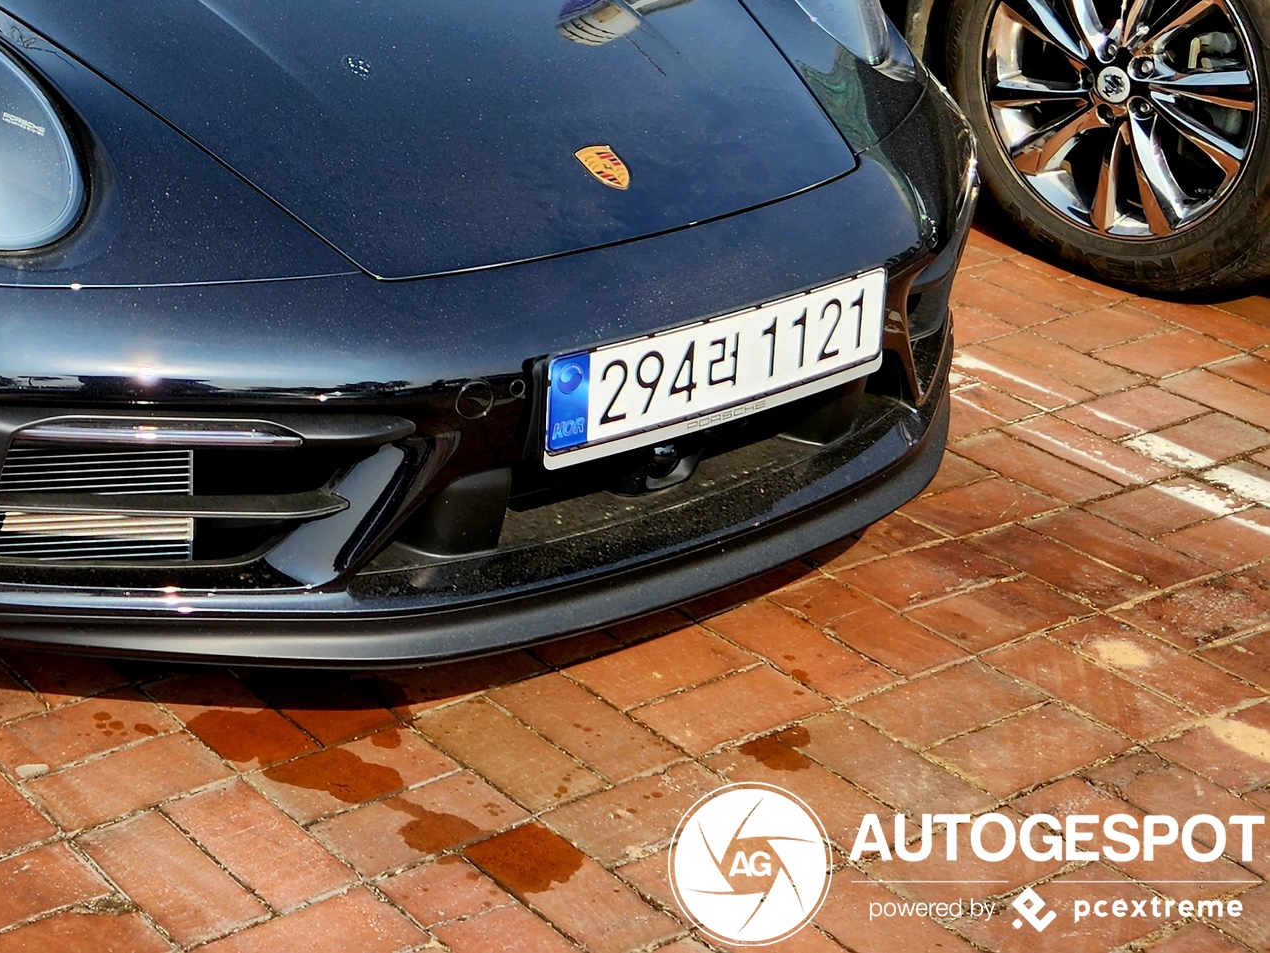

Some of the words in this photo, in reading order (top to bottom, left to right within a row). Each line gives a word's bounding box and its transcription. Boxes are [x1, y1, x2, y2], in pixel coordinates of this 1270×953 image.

[599, 332, 740, 427] 294러
[761, 288, 866, 379] 1121
[552, 416, 586, 440] KOR
[686, 399, 767, 431] PORSCHE
